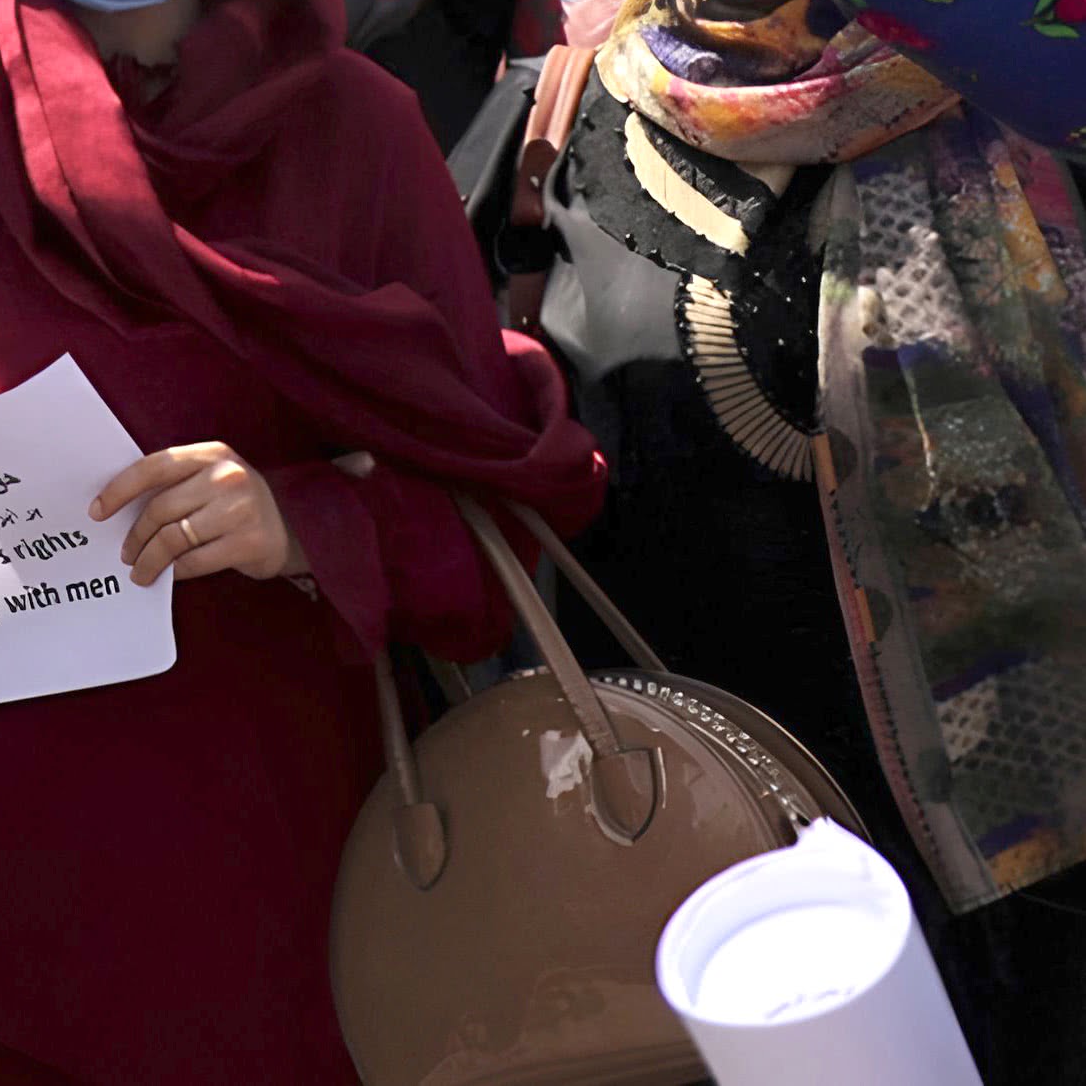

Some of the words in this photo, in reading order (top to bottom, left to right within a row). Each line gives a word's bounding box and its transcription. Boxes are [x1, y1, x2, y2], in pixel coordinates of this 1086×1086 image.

[13, 528, 90, 562] rights
[3, 581, 62, 614] with
[64, 574, 122, 604] men
